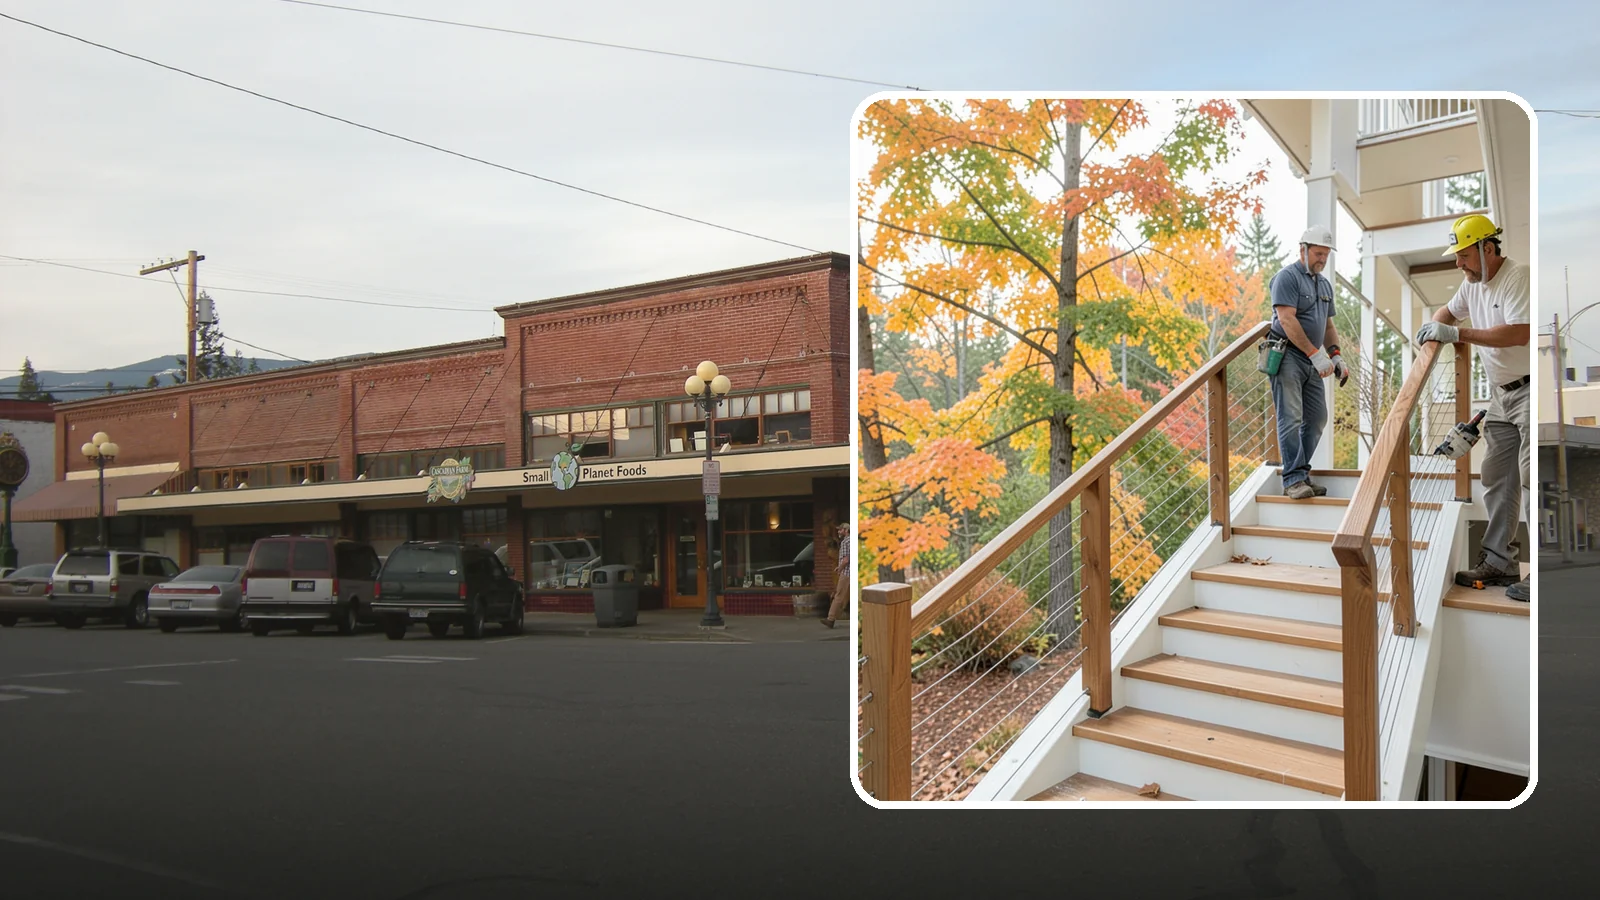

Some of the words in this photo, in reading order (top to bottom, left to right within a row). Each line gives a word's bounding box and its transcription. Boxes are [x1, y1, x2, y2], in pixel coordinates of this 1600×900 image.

[522, 471, 549, 483] Small
[583, 467, 614, 479] Planet
[617, 464, 647, 477] Foods
